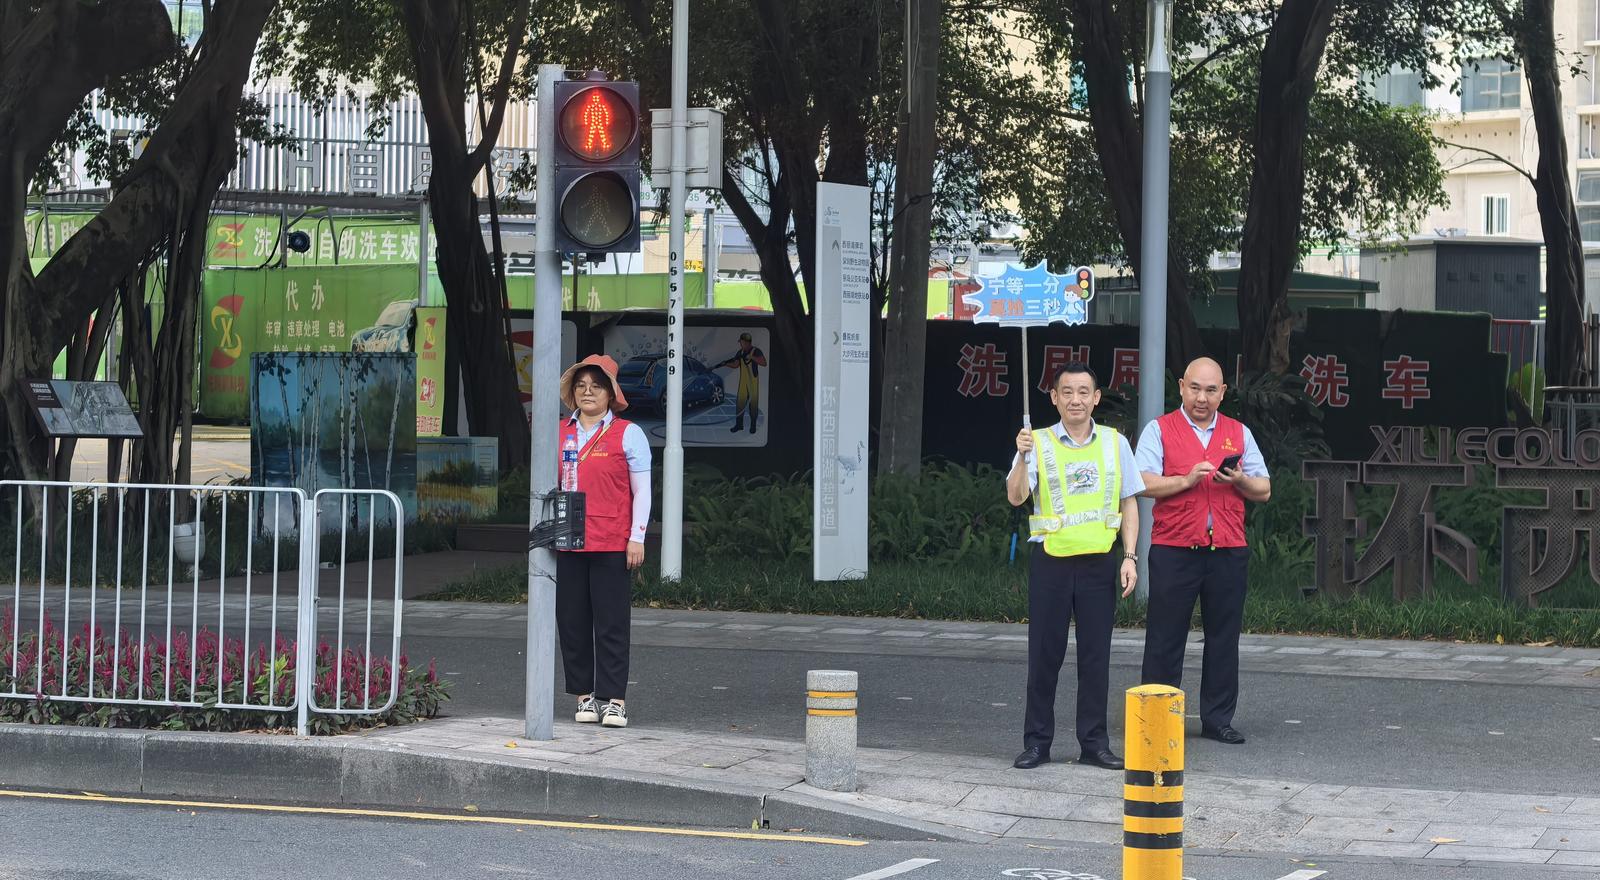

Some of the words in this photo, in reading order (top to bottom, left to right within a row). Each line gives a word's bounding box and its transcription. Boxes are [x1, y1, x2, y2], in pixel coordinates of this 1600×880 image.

[988, 276, 1060, 296] 宁等一分
[668, 251, 678, 375] 05570169
[265, 320, 281, 337] 年审
[287, 320, 320, 337] 违章处理
[328, 320, 345, 337] 电池
[1369, 425, 1452, 464] XILI
